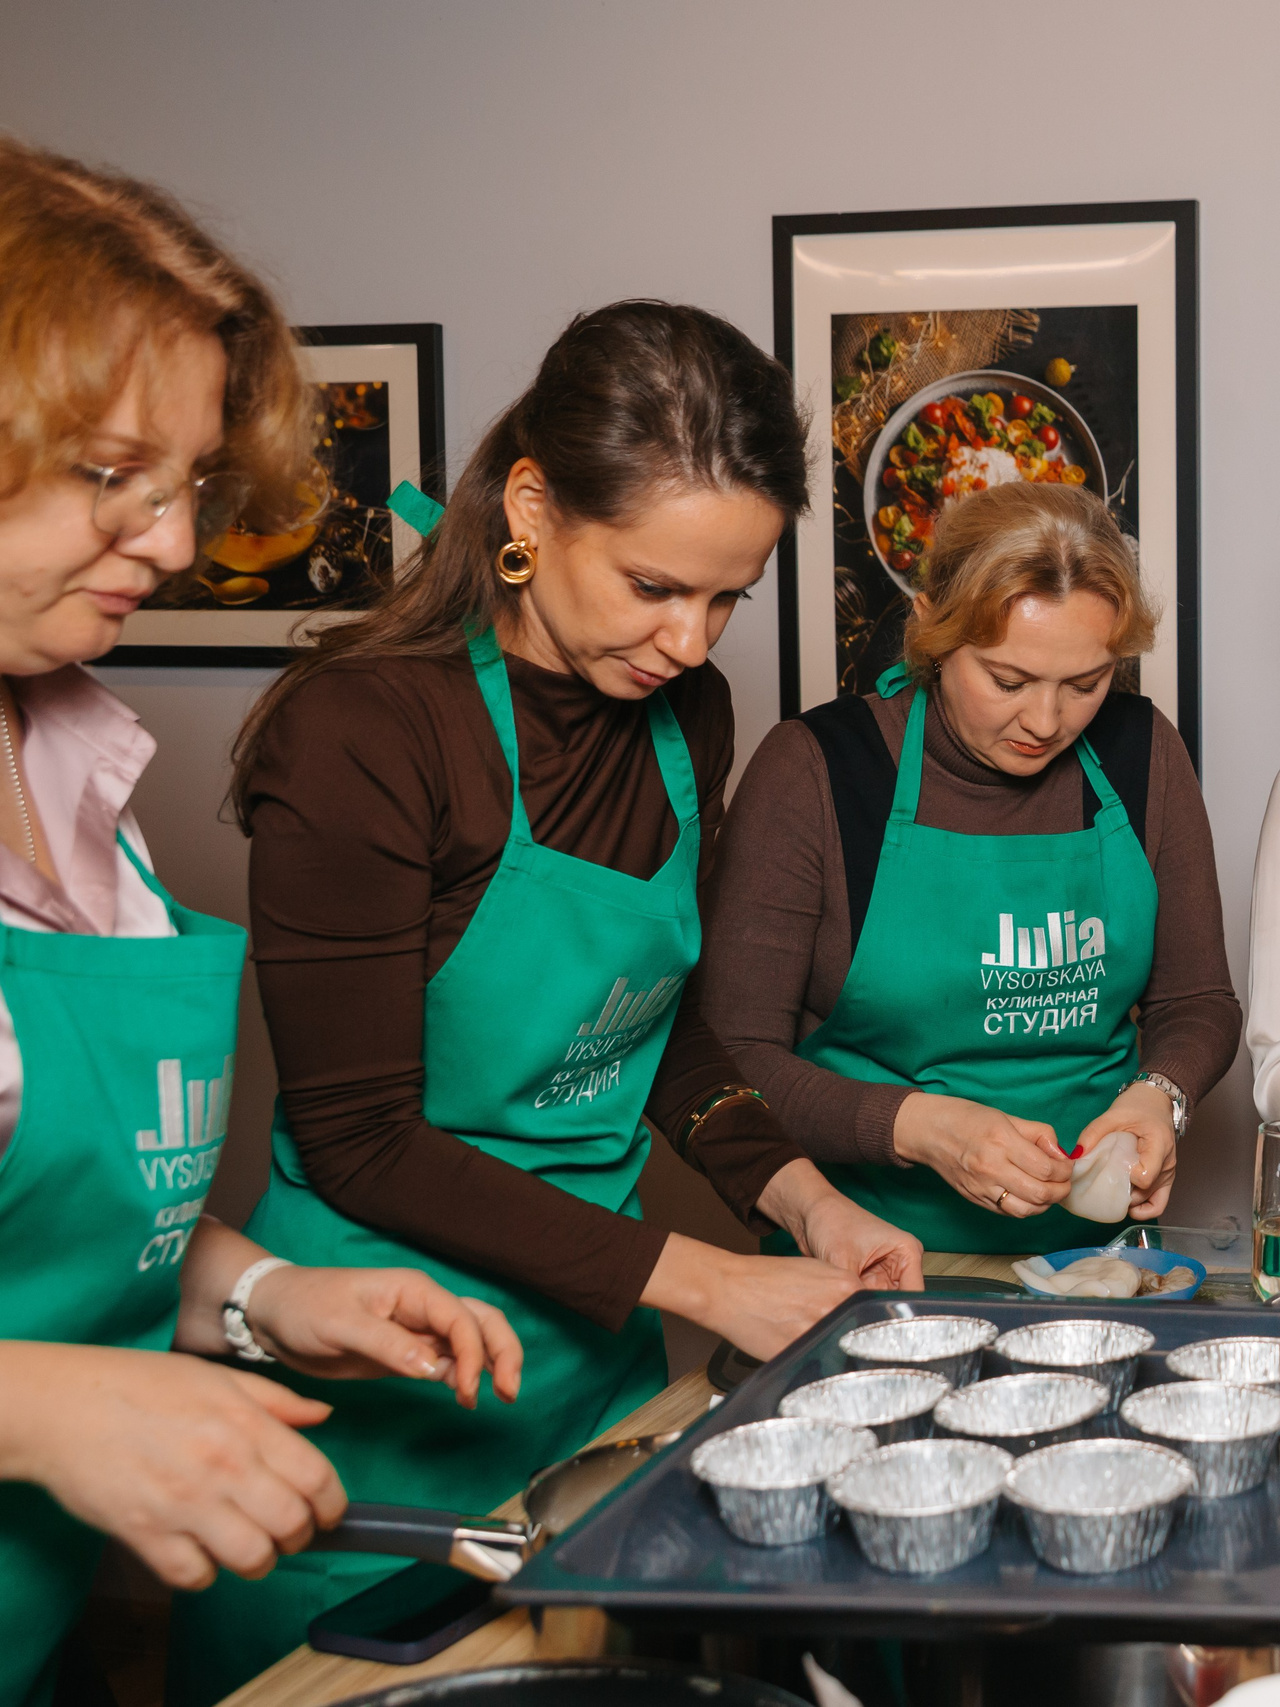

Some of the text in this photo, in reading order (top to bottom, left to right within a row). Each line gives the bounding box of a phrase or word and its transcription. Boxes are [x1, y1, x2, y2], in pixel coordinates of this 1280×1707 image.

[981, 910, 1106, 969] Julia
[980, 959, 1106, 990] VYSOTSKAYA
[986, 987, 1099, 1010] КУЛИНАРНАЯ
[983, 1003, 1098, 1036] СТУДИЯ
[534, 1061, 621, 1109] СТУДИЯ
